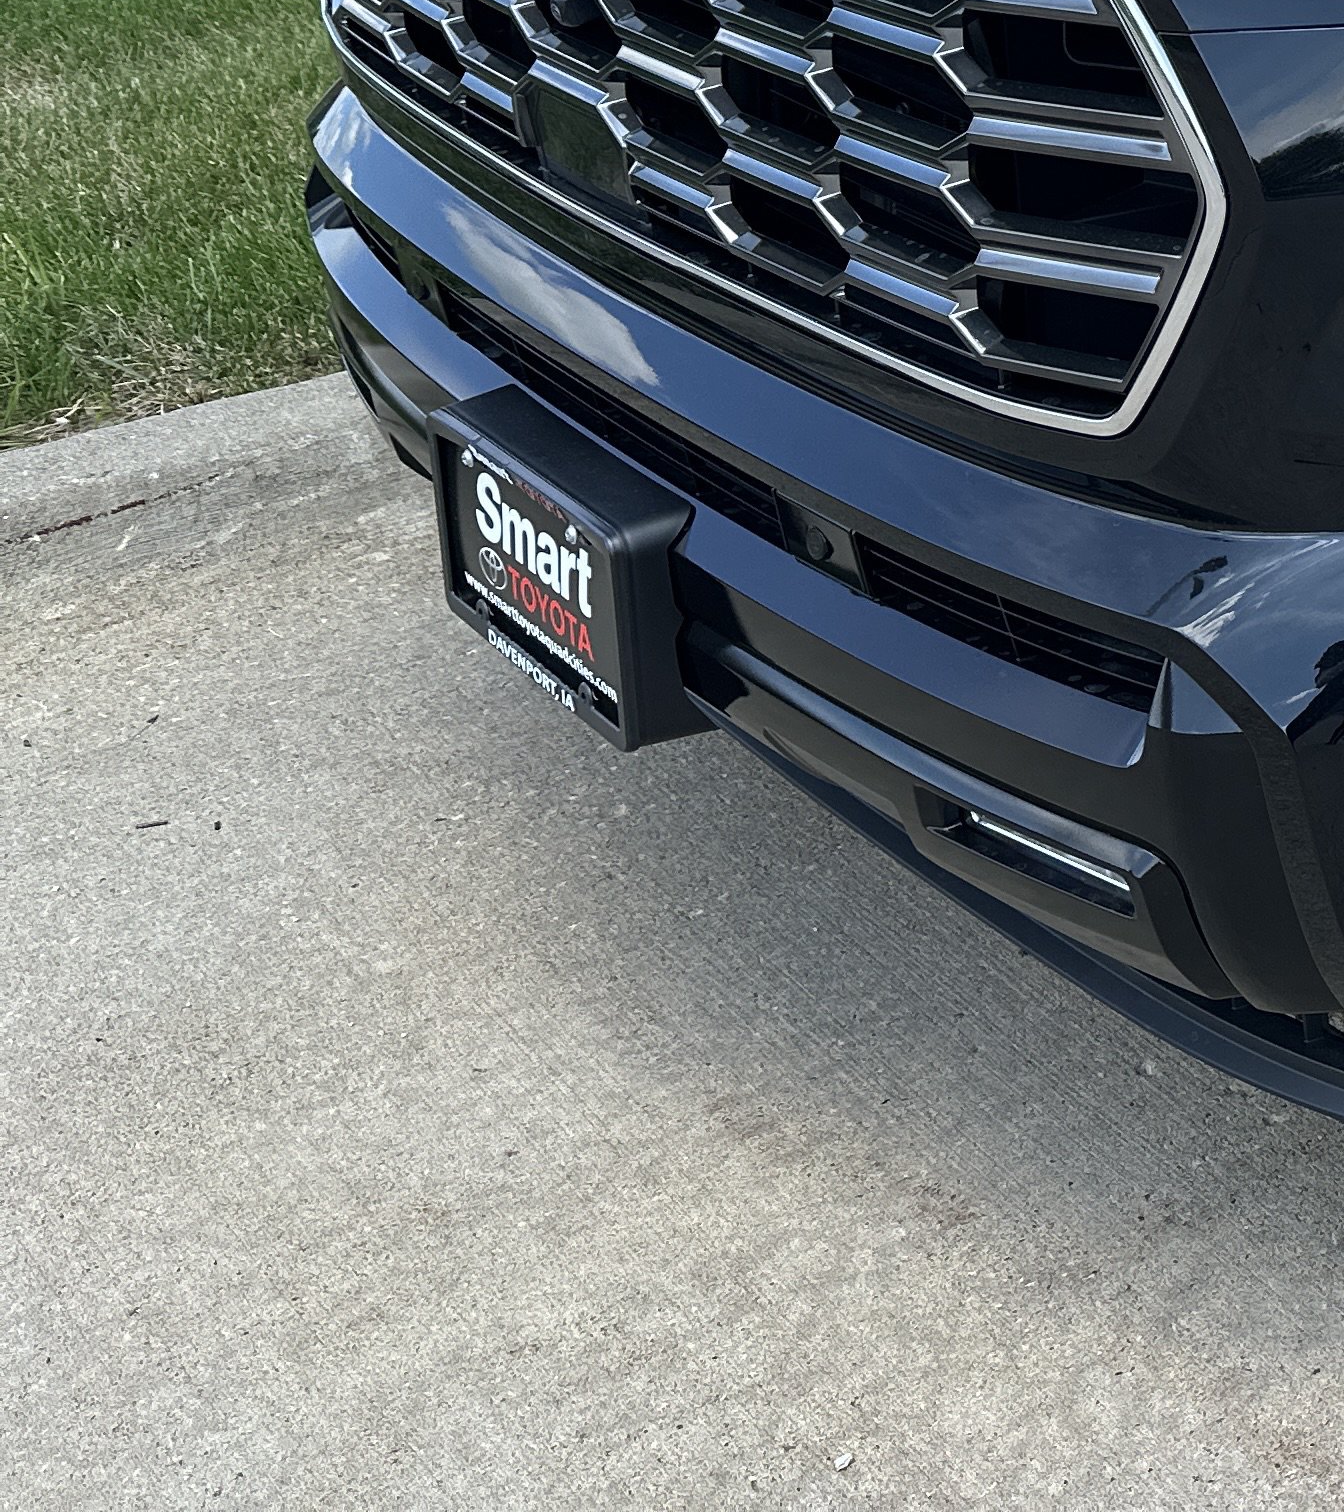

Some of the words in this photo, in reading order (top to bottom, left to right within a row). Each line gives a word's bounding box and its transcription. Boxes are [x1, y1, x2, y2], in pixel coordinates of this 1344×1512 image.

[475, 471, 593, 619] Smart
[507, 565, 595, 662] TOYOTA
[488, 629, 559, 701] DAVENPORT,
[561, 691, 575, 712] IA
